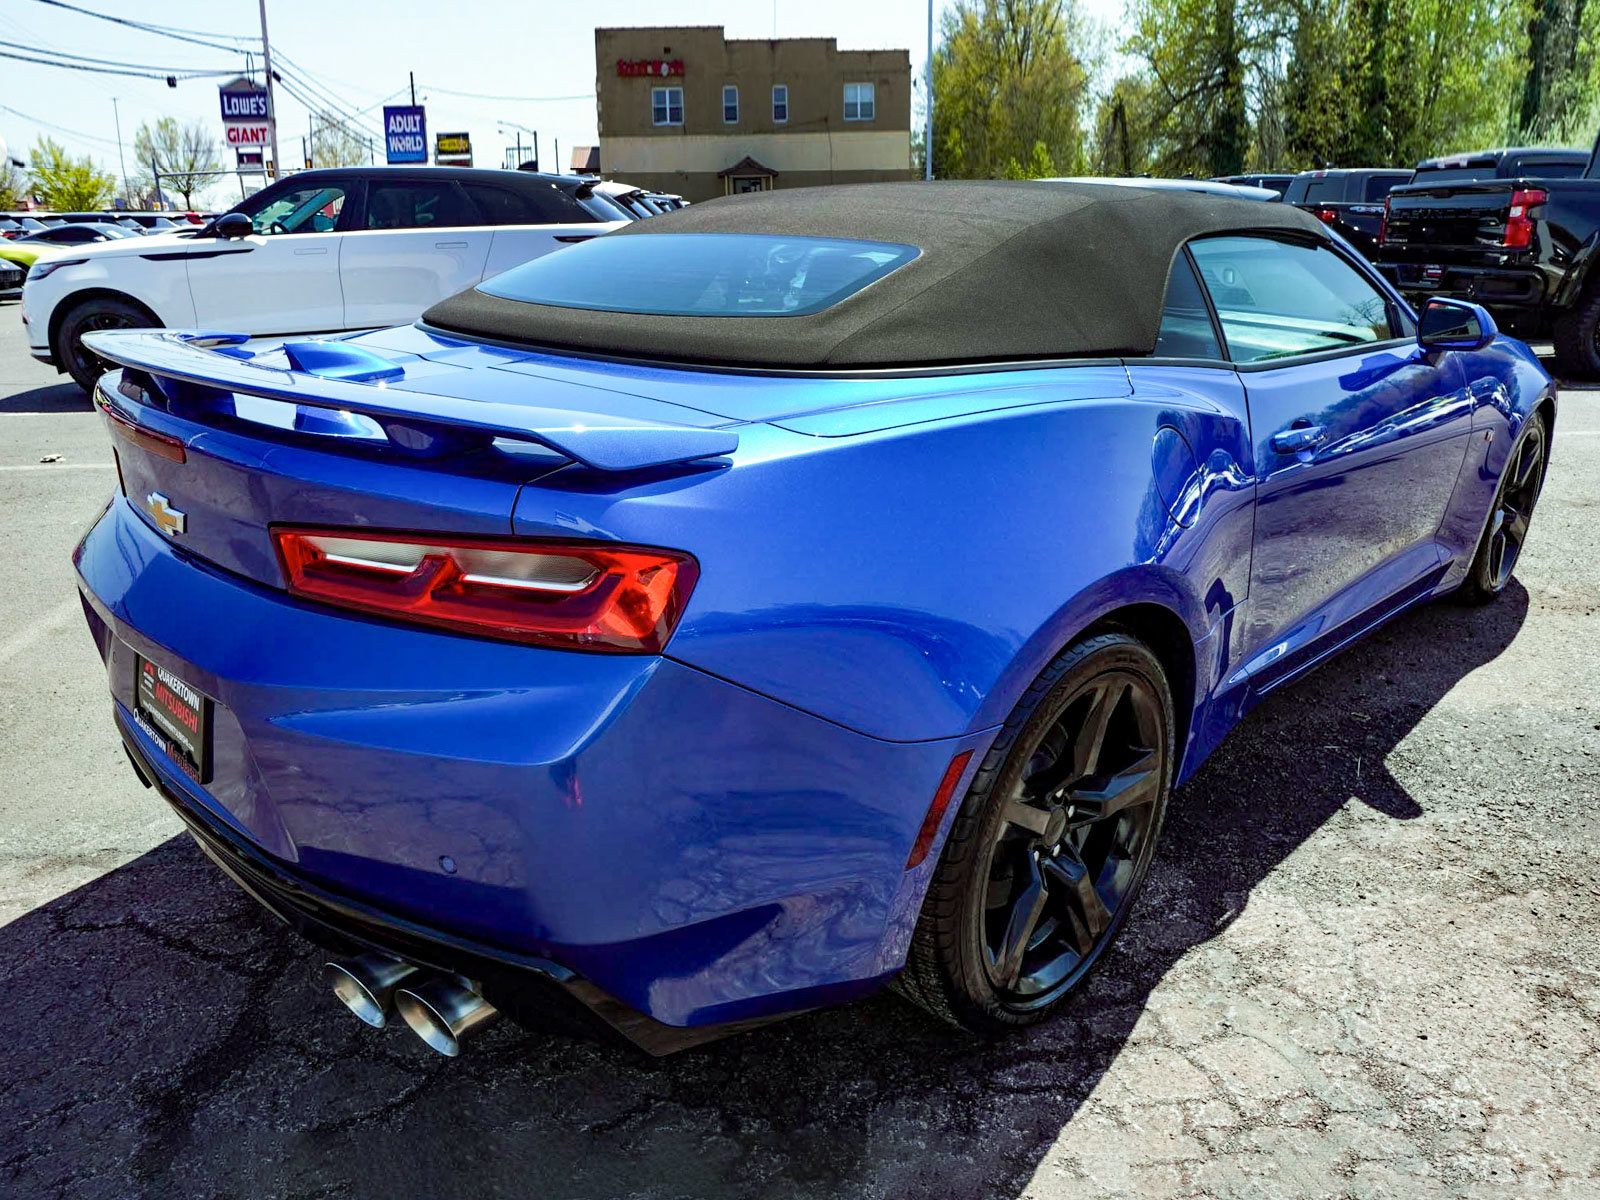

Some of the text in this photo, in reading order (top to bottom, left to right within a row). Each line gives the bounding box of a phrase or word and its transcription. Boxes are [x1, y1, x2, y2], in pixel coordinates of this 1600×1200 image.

[223, 94, 266, 115] LOWE'S
[388, 115, 420, 133] ADULT
[227, 127, 267, 143] GIANT
[389, 135, 424, 153] WORLD
[157, 667, 200, 712] QUAKERTOWN
[155, 682, 199, 734] MITSUBISHI
